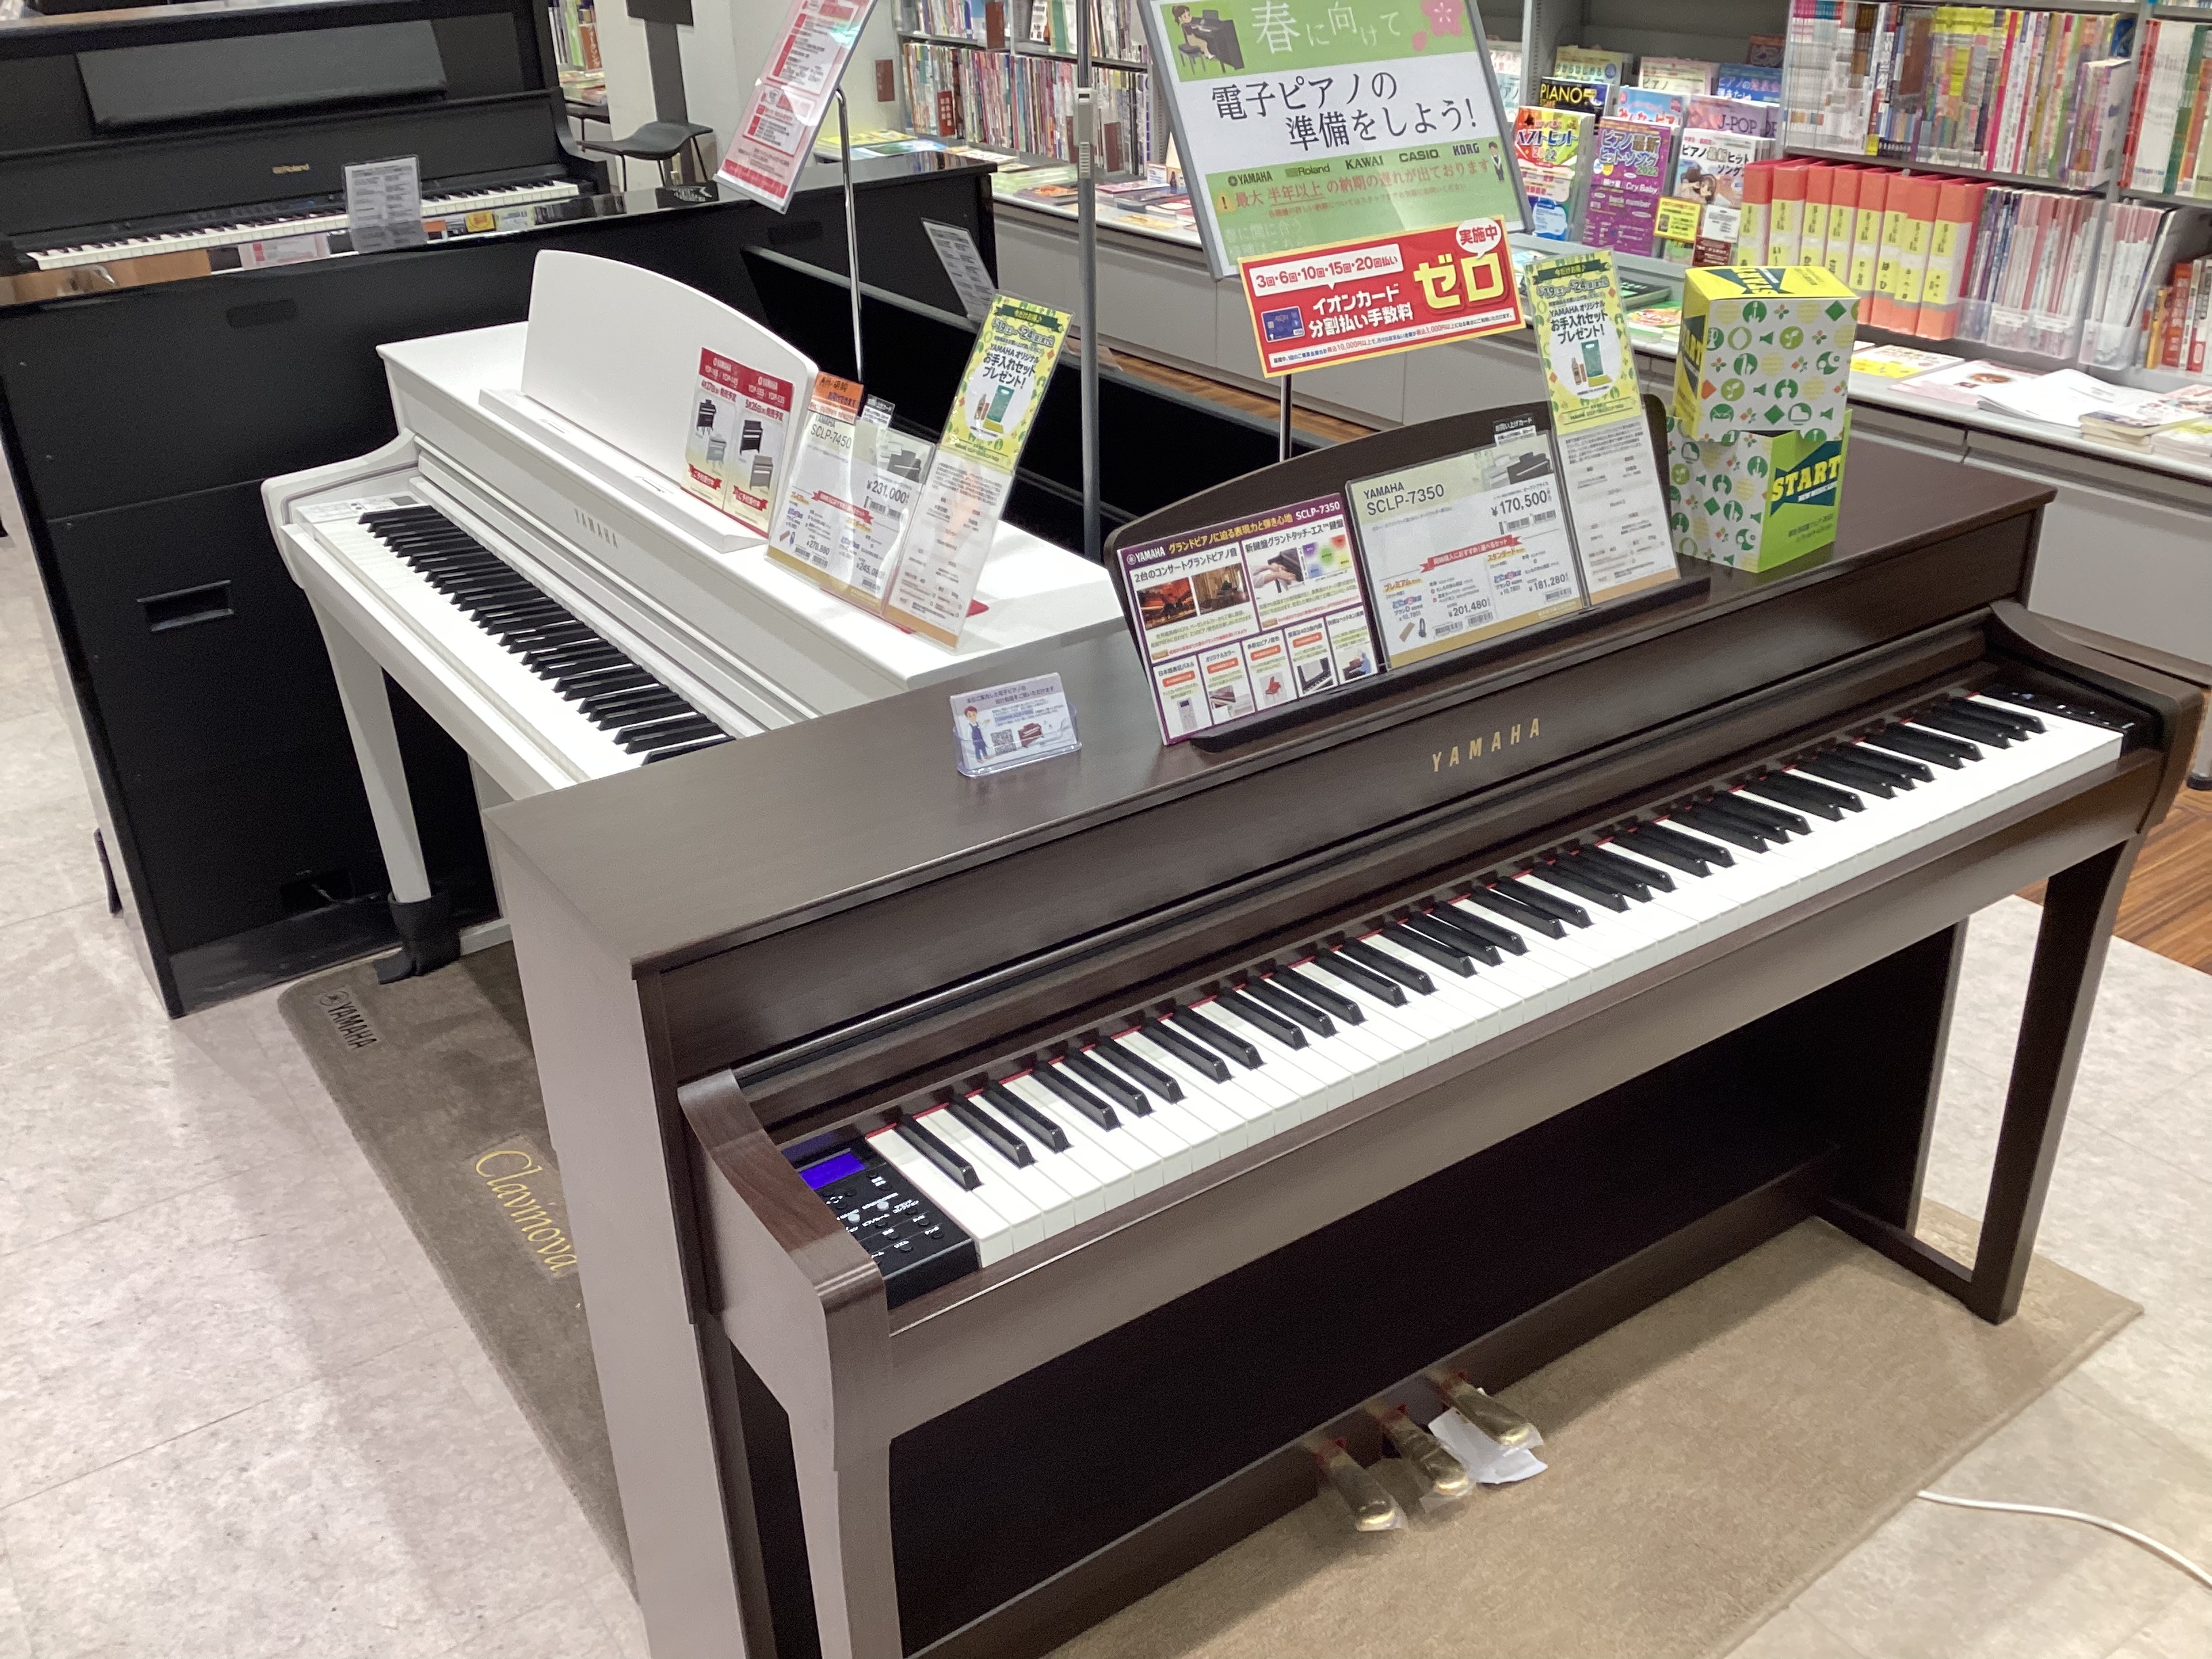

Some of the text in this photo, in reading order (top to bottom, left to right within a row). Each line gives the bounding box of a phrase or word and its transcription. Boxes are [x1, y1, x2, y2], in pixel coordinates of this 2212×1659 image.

[1251, 1, 1401, 54] 春に向けて
[1212, 71, 1397, 119] 電子ピアノの
[1540, 83, 1582, 104] PIANO
[1286, 98, 1477, 151] 準備をしよう!
[1718, 115, 1757, 134] J-POP
[1399, 149, 1440, 162] CASIO
[1453, 143, 1480, 156] KORG
[1298, 164, 1330, 176] Roland
[1345, 156, 1384, 170] KAWAI
[1237, 171, 1273, 185] YAMAHA
[1235, 190, 1264, 207] 最大
[1269, 182, 1324, 201] 半年以上
[1459, 223, 1498, 245] 実施中
[1414, 252, 1504, 309] ゼロ
[1313, 283, 1401, 316] イオンカード
[1549, 306, 1580, 318] YAMAHA
[1309, 302, 1414, 338] 分割払い手数料
[1551, 312, 1608, 332] お手入れセット
[990, 343, 1015, 357] YAMAHA
[983, 352, 1036, 377] お手入れセット
[811, 424, 853, 449] SCLP-7450
[1364, 480, 1405, 500] YAMAHA
[1770, 454, 1842, 502] START
[1295, 501, 1341, 521] SCLP-7350
[1367, 483, 1445, 516] SCLP-7350
[1490, 489, 1548, 518] ¥170,500
[1134, 546, 1166, 564] YAMAHA
[1432, 718, 1540, 773] YAMAHA
[327, 1001, 377, 1050] YAMAHA
[475, 1149, 578, 1273] Clavinova
